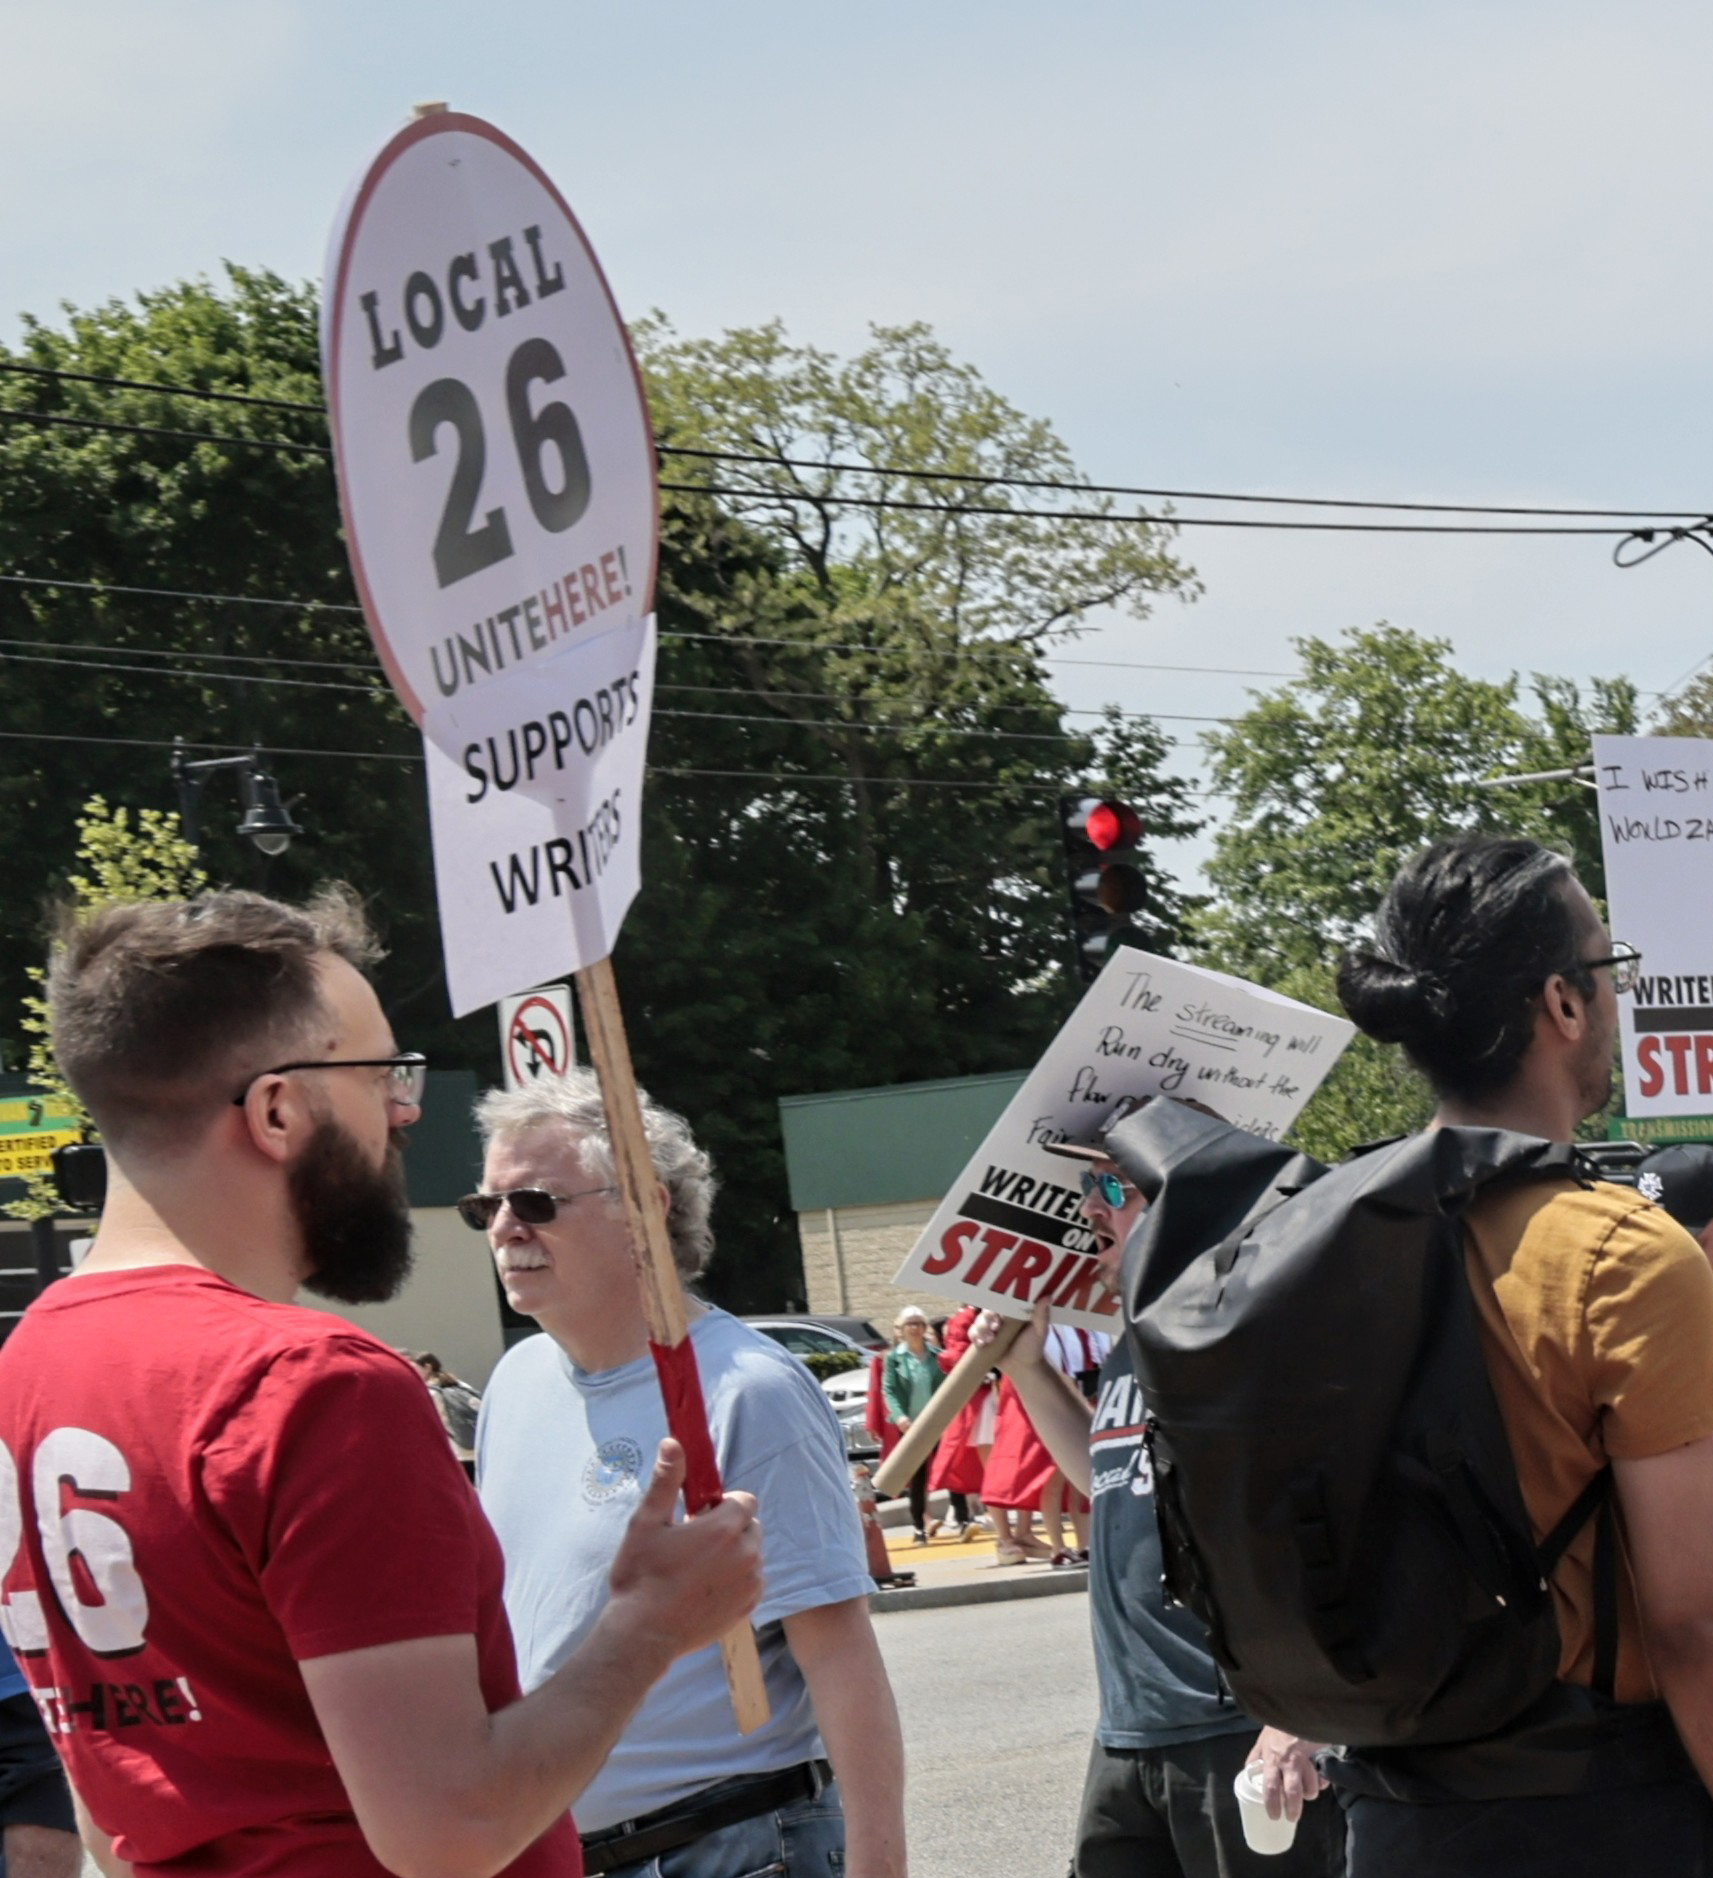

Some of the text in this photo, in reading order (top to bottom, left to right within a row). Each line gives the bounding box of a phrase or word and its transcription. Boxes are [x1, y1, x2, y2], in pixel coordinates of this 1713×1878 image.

[359, 224, 566, 371] LOCAL
[408, 337, 592, 589] 26
[431, 546, 634, 698] UNITEHERE!
[463, 671, 640, 805] SUPPORTS
[1602, 765, 1630, 791] I
[1641, 768, 1709, 794] WISH
[489, 789, 622, 914] WRITERS
[1607, 814, 1681, 844] WOULD
[1095, 1025, 1301, 1100] Run dry without the
[1118, 971, 1160, 1013] The
[1174, 1001, 1281, 1058] streaming
[1061, 1227, 1097, 1251] ON
